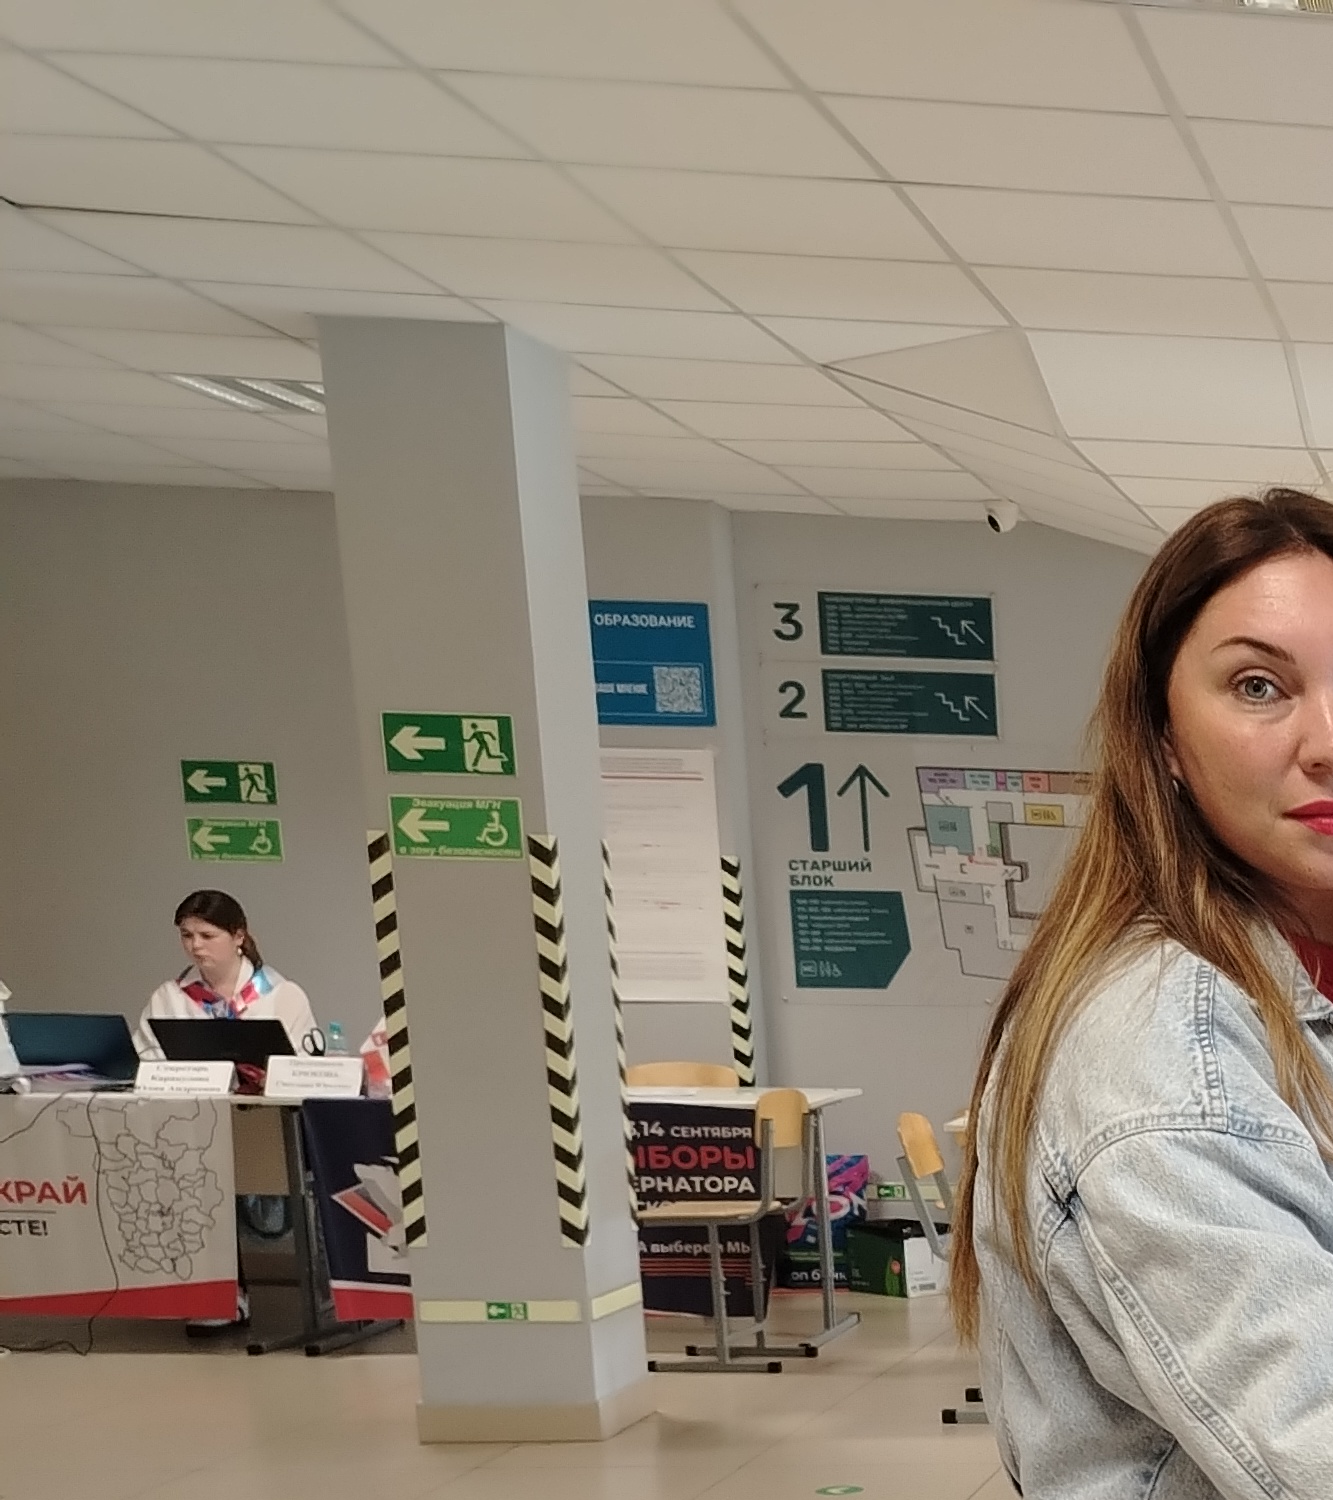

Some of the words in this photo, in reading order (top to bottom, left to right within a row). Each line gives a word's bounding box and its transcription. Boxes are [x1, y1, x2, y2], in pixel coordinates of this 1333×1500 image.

[594, 613, 697, 629] ОБРАЗОВАНИЕ
[772, 602, 804, 642] 3
[778, 680, 809, 719] 2
[776, 762, 830, 853] 1
[788, 858, 873, 873] СТАРШИЙ
[789, 875, 835, 888] БЛОК
[670, 1125, 753, 1139] СЕНТЯБРЯ
